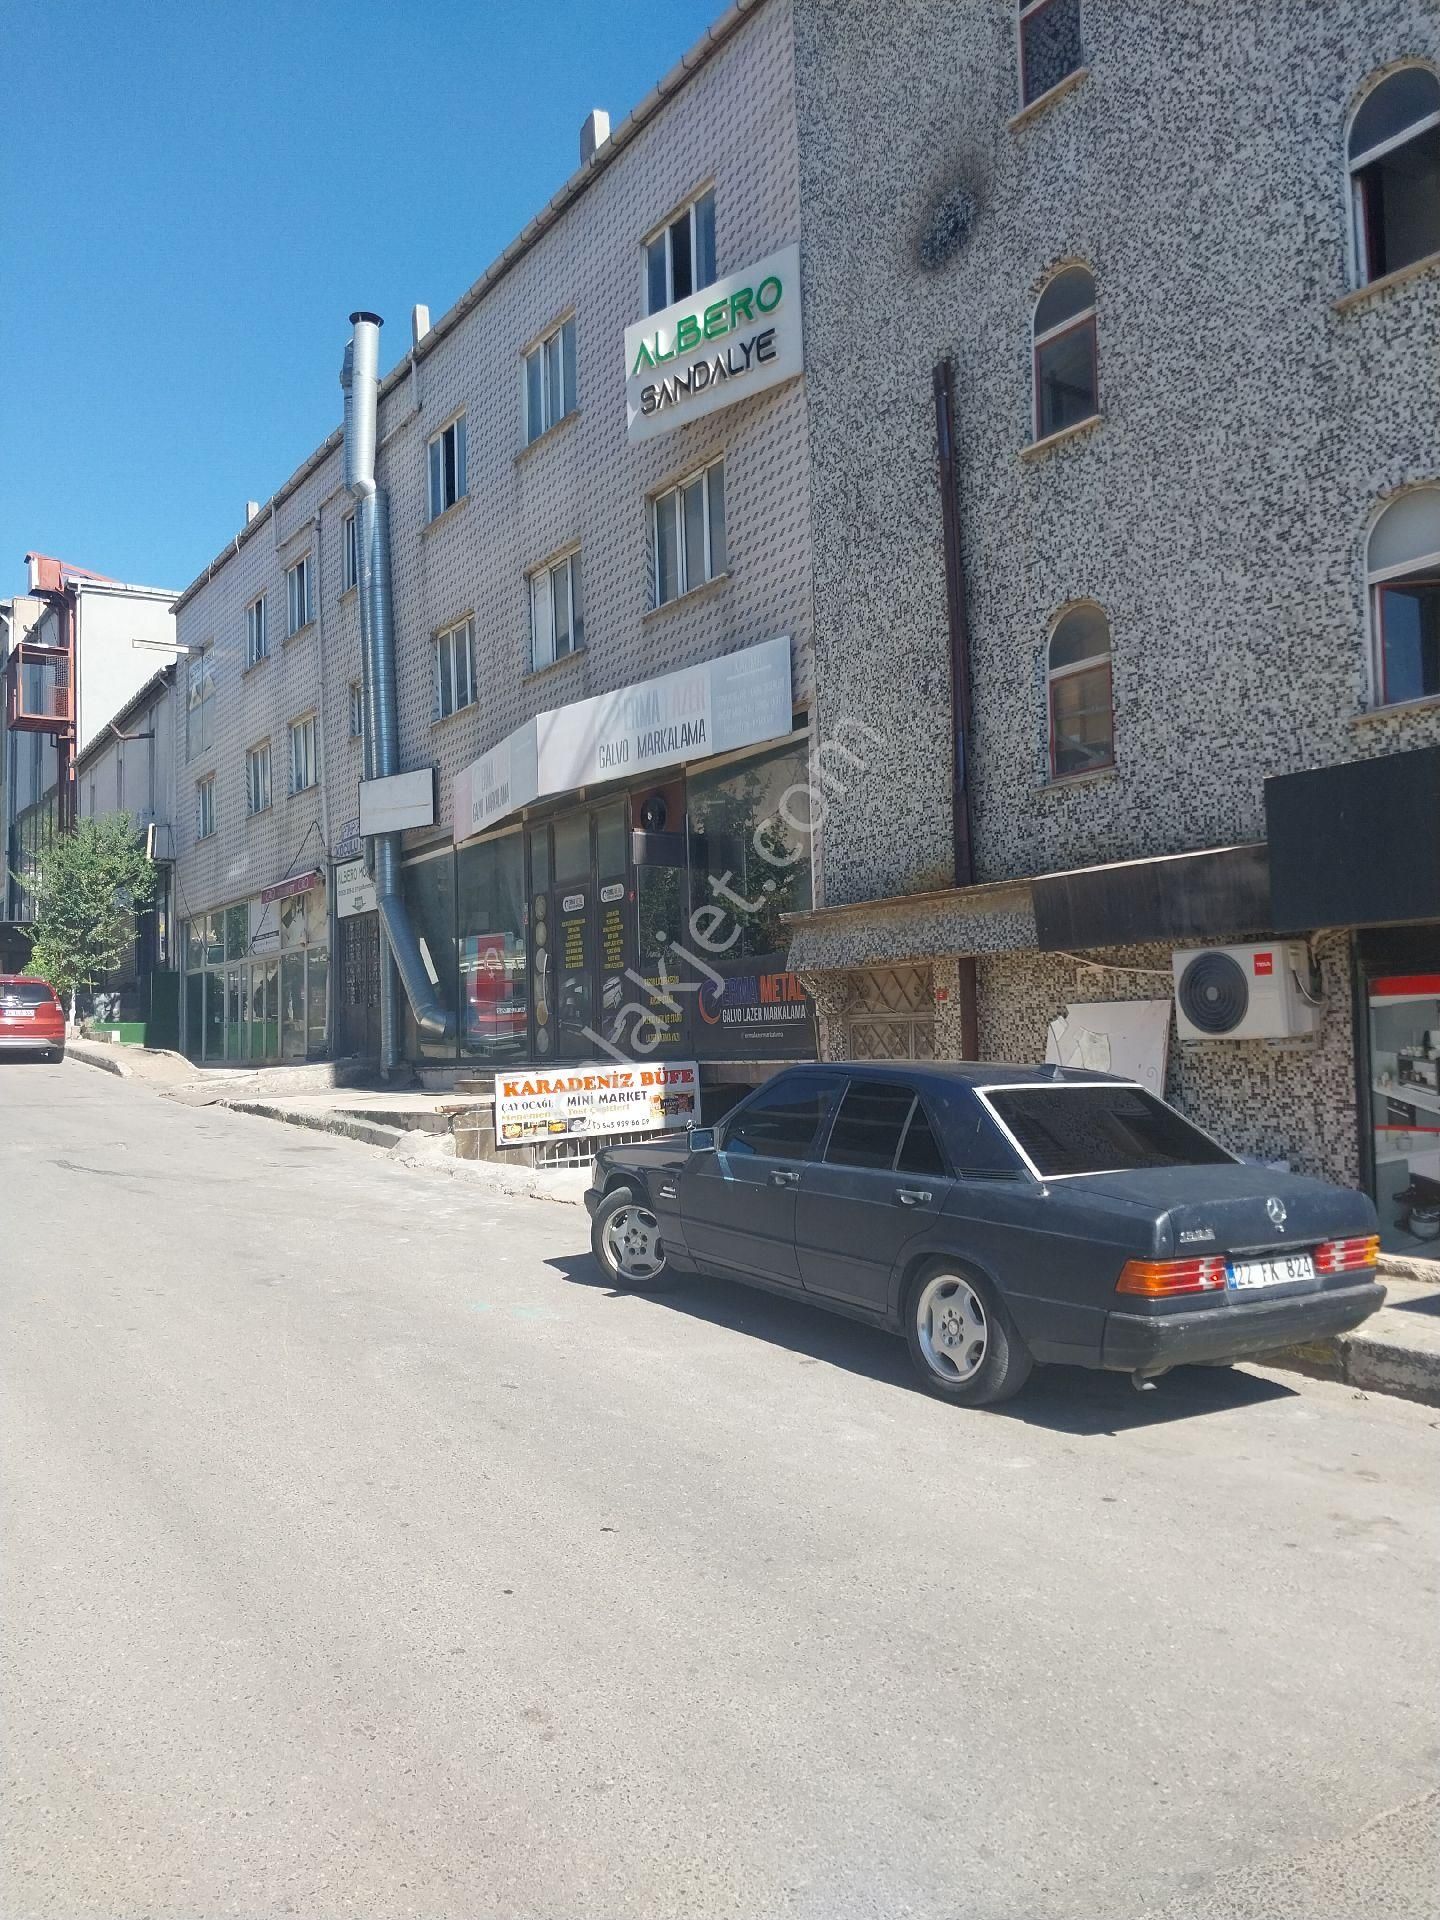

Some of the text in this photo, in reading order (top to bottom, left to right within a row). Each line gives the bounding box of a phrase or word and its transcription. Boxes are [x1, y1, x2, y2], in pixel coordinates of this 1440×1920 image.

[632, 276, 783, 376] ALBERO
[640, 327, 778, 416] SANDALYE
[599, 718, 707, 769] GALVO MARKALAMA
[722, 972, 806, 1006] ERMA METAL
[722, 1004, 806, 1023] GALVO LAZER MARKALAMA
[503, 1066, 695, 1098] KARADENİZ BÜFE
[567, 1091, 594, 1108] MİNİ
[598, 1090, 648, 1105] MARKET
[1235, 1256, 1312, 1286] 22 FK 824
